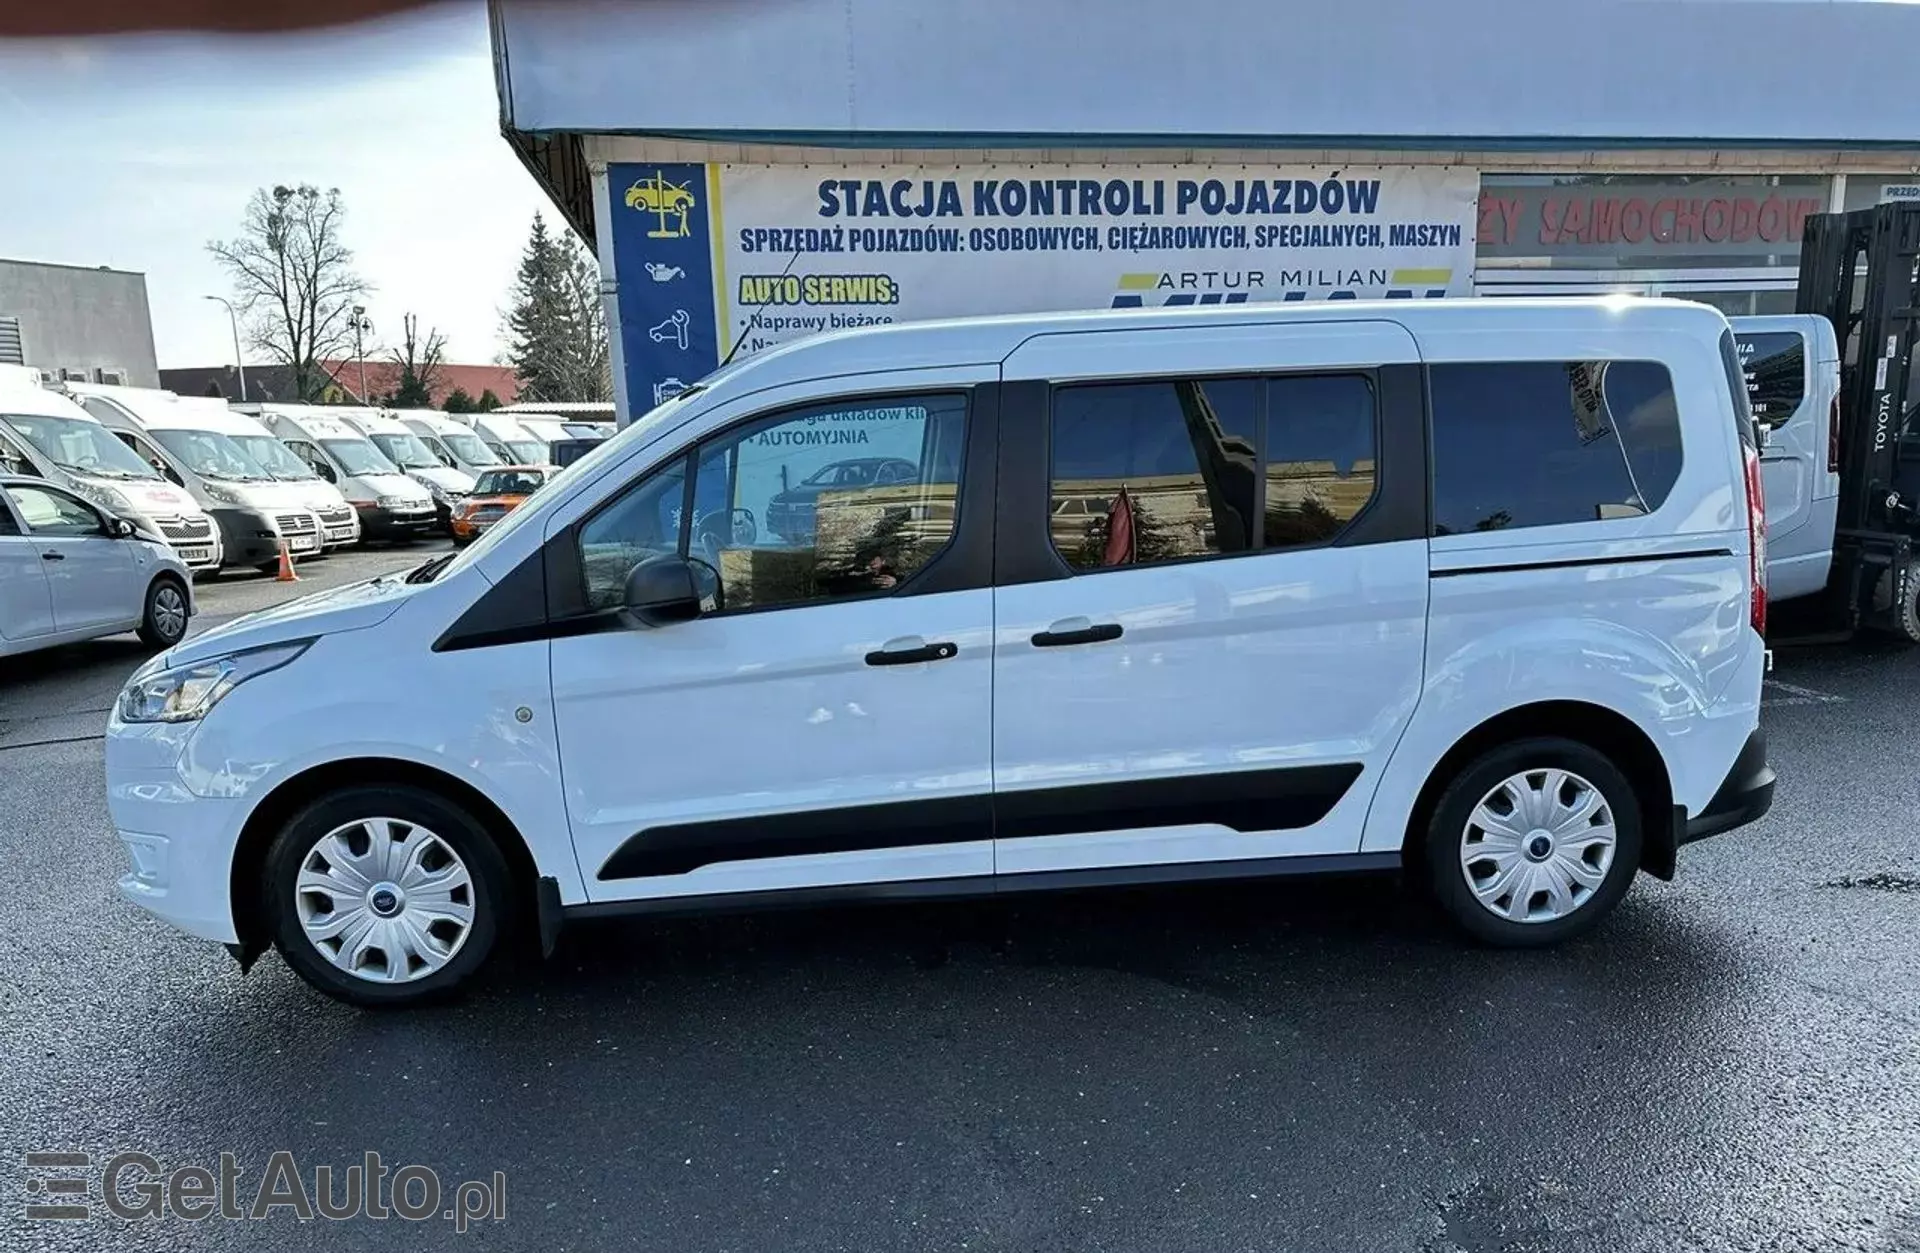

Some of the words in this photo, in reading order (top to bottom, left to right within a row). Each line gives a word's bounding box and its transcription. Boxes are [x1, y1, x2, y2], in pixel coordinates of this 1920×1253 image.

[818, 179, 963, 217] STACJA
[974, 179, 1164, 216] KONTROLI
[1177, 172, 1380, 215] POJAZDÓW
[740, 224, 844, 253] SPRZEDAŻ
[849, 224, 965, 252] POJAZDÓW:
[969, 226, 1103, 254] OSOBOWYCH,
[1107, 222, 1250, 253] CIĘŻAROWYCH,
[1254, 224, 1385, 250] SPECJALNYCH,
[1389, 224, 1461, 247] MASZYN
[739, 275, 800, 305] AUTO
[802, 275, 899, 305] SERWIS:
[1157, 271, 1265, 289] ARTUR
[1281, 269, 1387, 286] MILIAN
[750, 314, 826, 332] Naprawy
[758, 429, 869, 446] AUTOMYJNIA
[1874, 393, 1891, 452] TOYOTA
